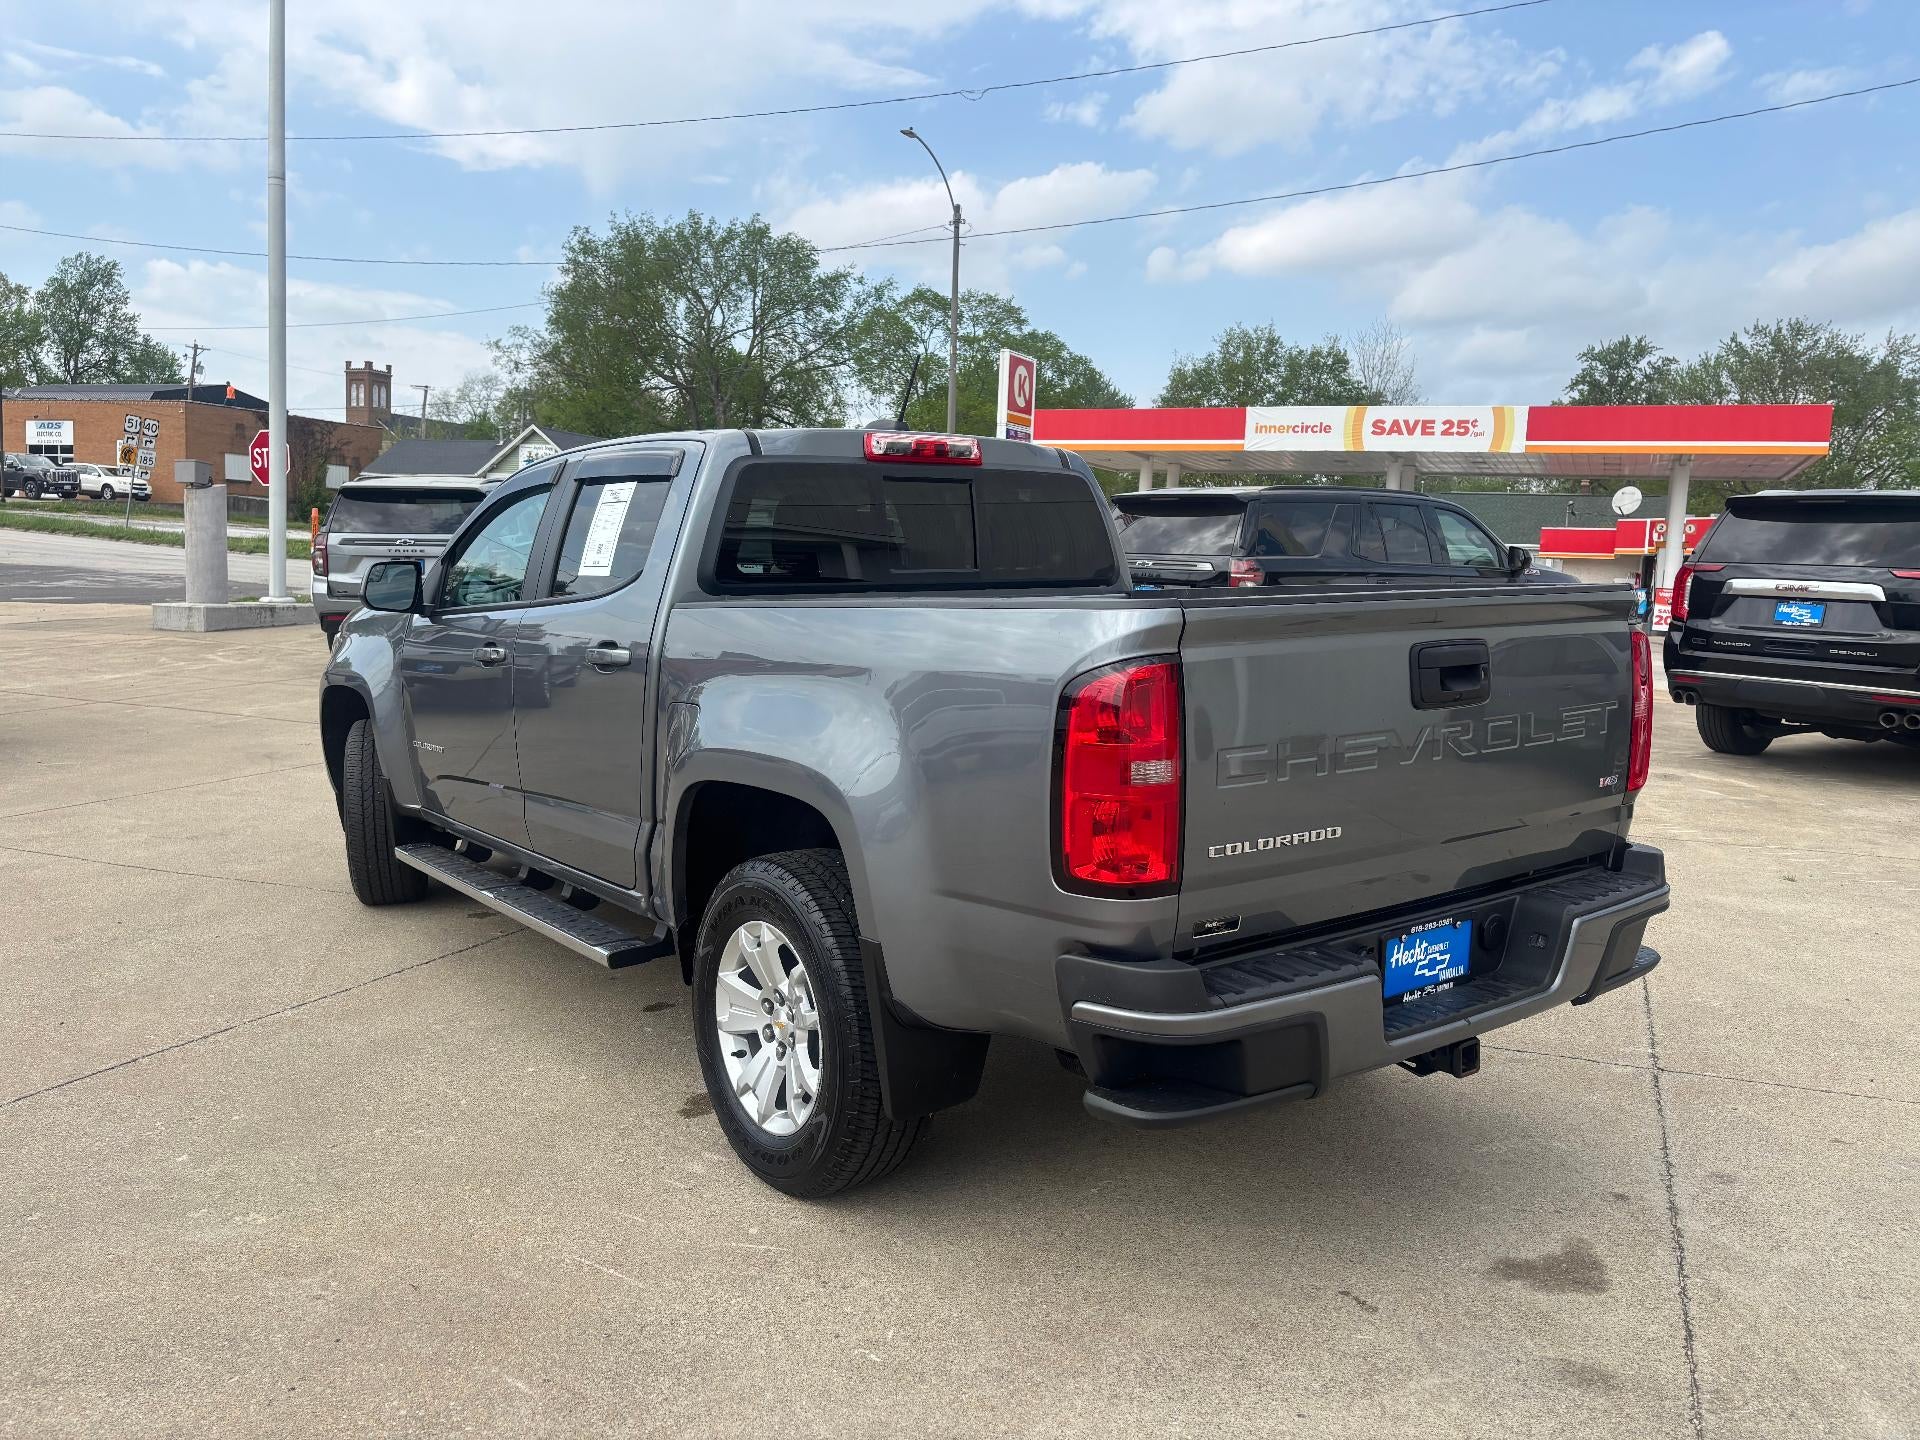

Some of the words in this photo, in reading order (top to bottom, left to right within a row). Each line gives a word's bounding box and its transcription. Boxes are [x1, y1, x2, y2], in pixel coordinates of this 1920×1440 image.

[1017, 373, 1028, 403] K
[127, 418, 138, 430] 51
[144, 422, 158, 433] 40
[1254, 422, 1333, 434] innercircle
[1370, 418, 1436, 437] SAVE
[139, 455, 154, 466] 185
[253, 447, 269, 469] ST
[1775, 583, 1820, 593] GMC
[1713, 640, 1752, 648] YUKON
[1829, 648, 1878, 657] DENALI
[1216, 701, 1618, 789] CHEVROLET
[1208, 826, 1342, 858] COLORADO
[1390, 938, 1428, 969] Hecht
